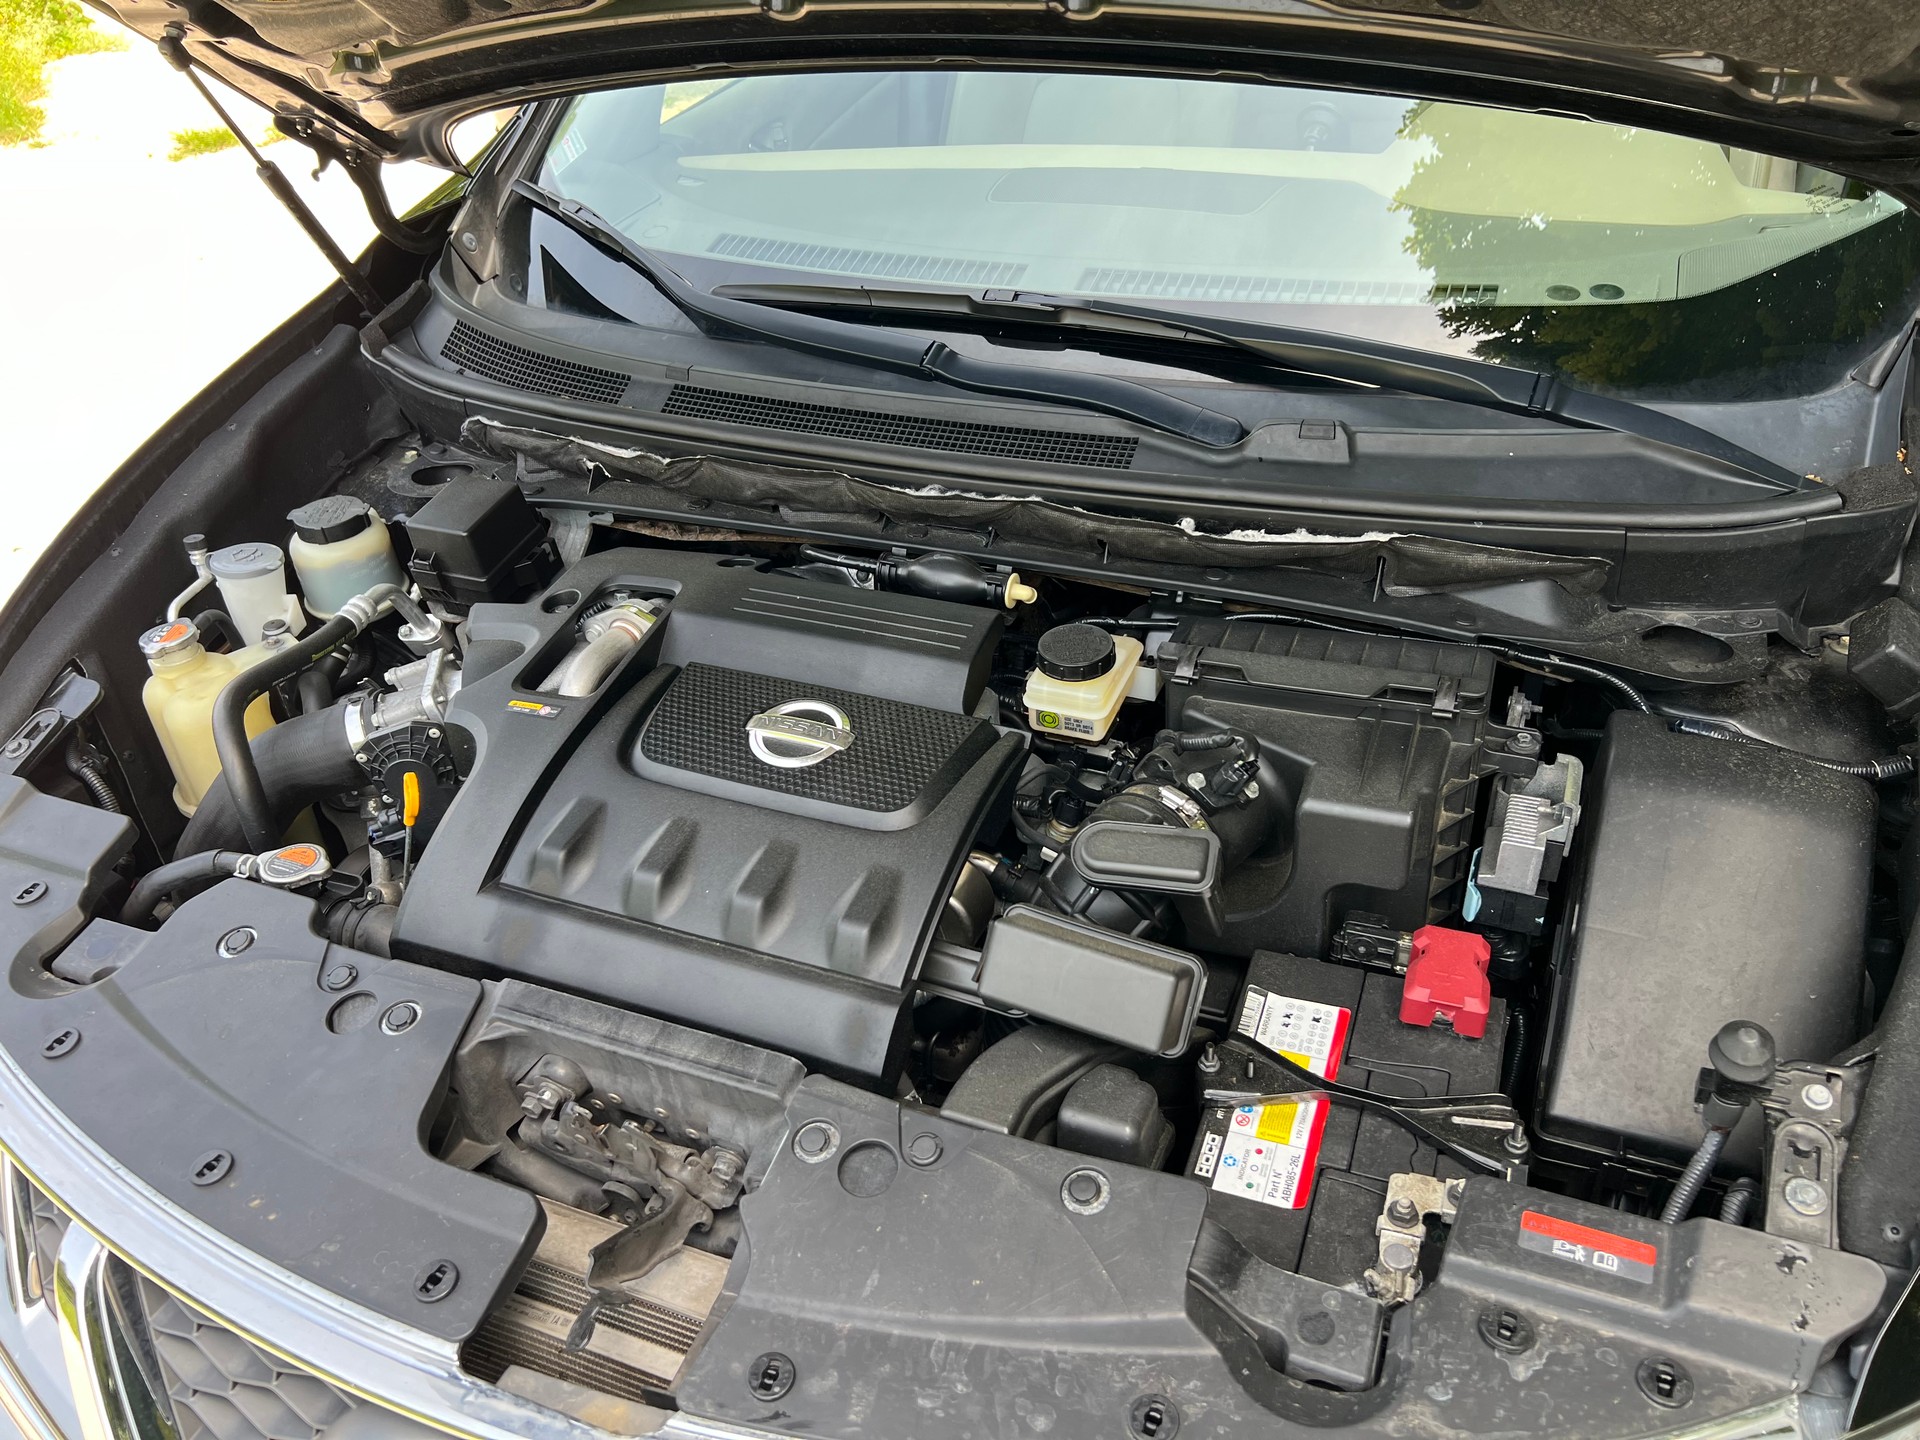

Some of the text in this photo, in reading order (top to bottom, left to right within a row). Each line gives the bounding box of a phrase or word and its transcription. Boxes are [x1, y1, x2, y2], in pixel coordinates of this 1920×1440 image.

[760, 715, 843, 741] NISSAN
[1260, 1005, 1274, 1036] WARRANTY
[1237, 1148, 1251, 1180] INDICATOR
[1281, 1153, 1301, 1202] ABH085-26L
[1268, 1179, 1279, 1198] Part
